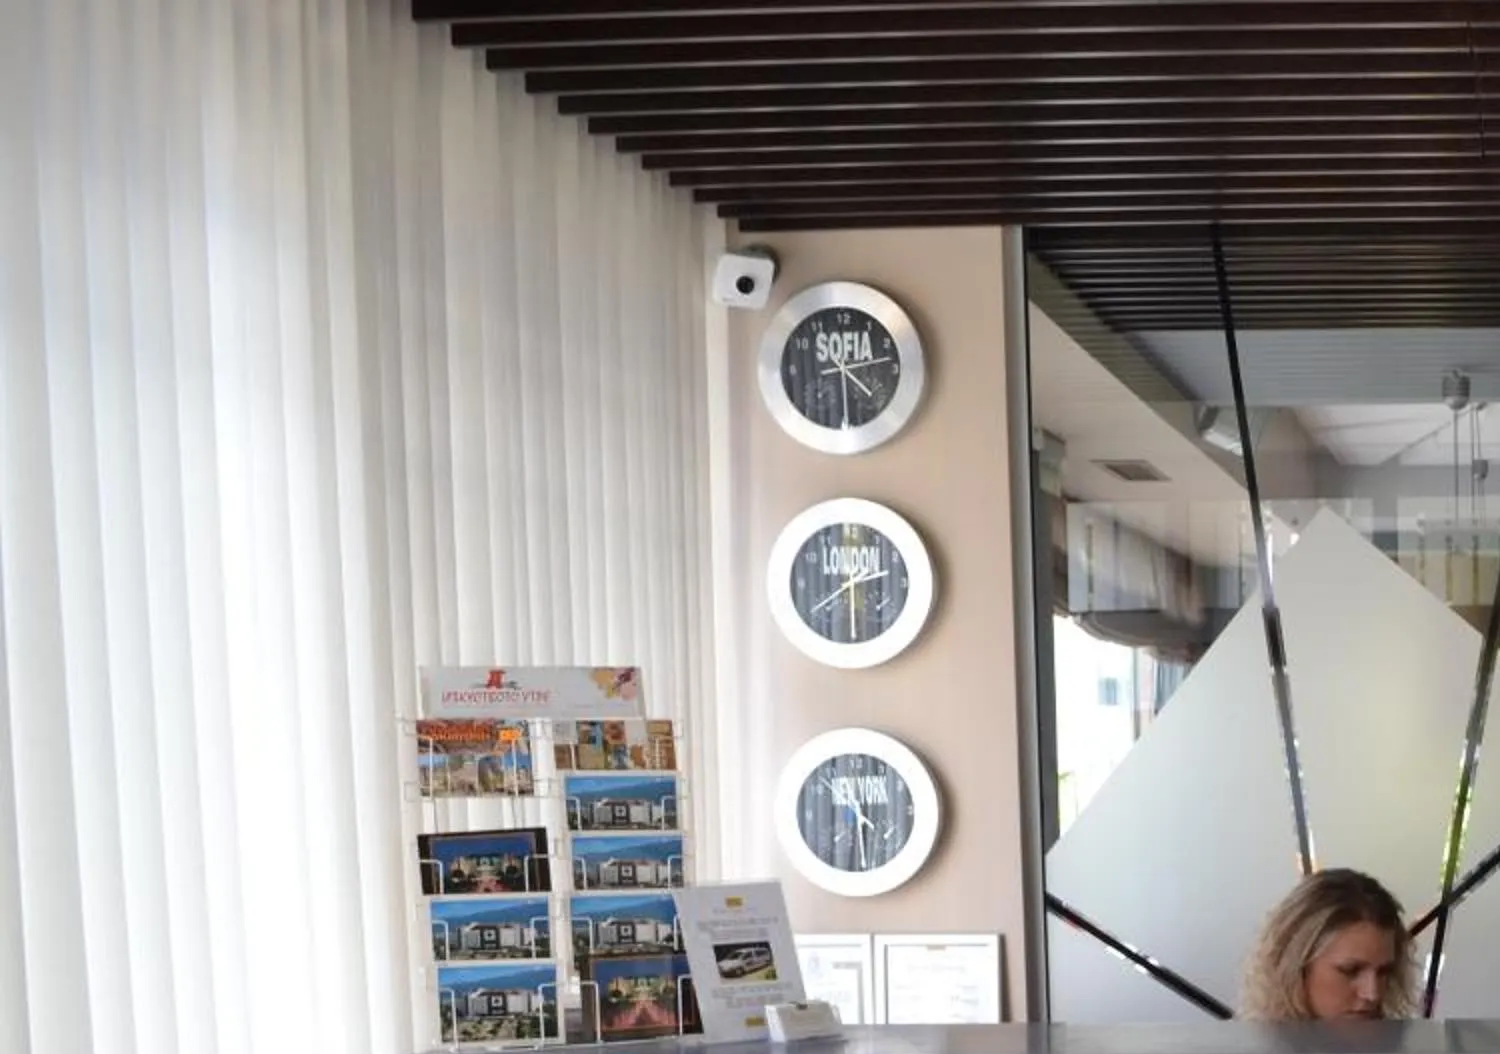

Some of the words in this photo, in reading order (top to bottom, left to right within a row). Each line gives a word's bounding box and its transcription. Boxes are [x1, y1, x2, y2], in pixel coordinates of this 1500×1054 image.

[815, 331, 874, 363] SOFIA
[822, 545, 880, 575] LONDON
[858, 775, 888, 804] YORK
